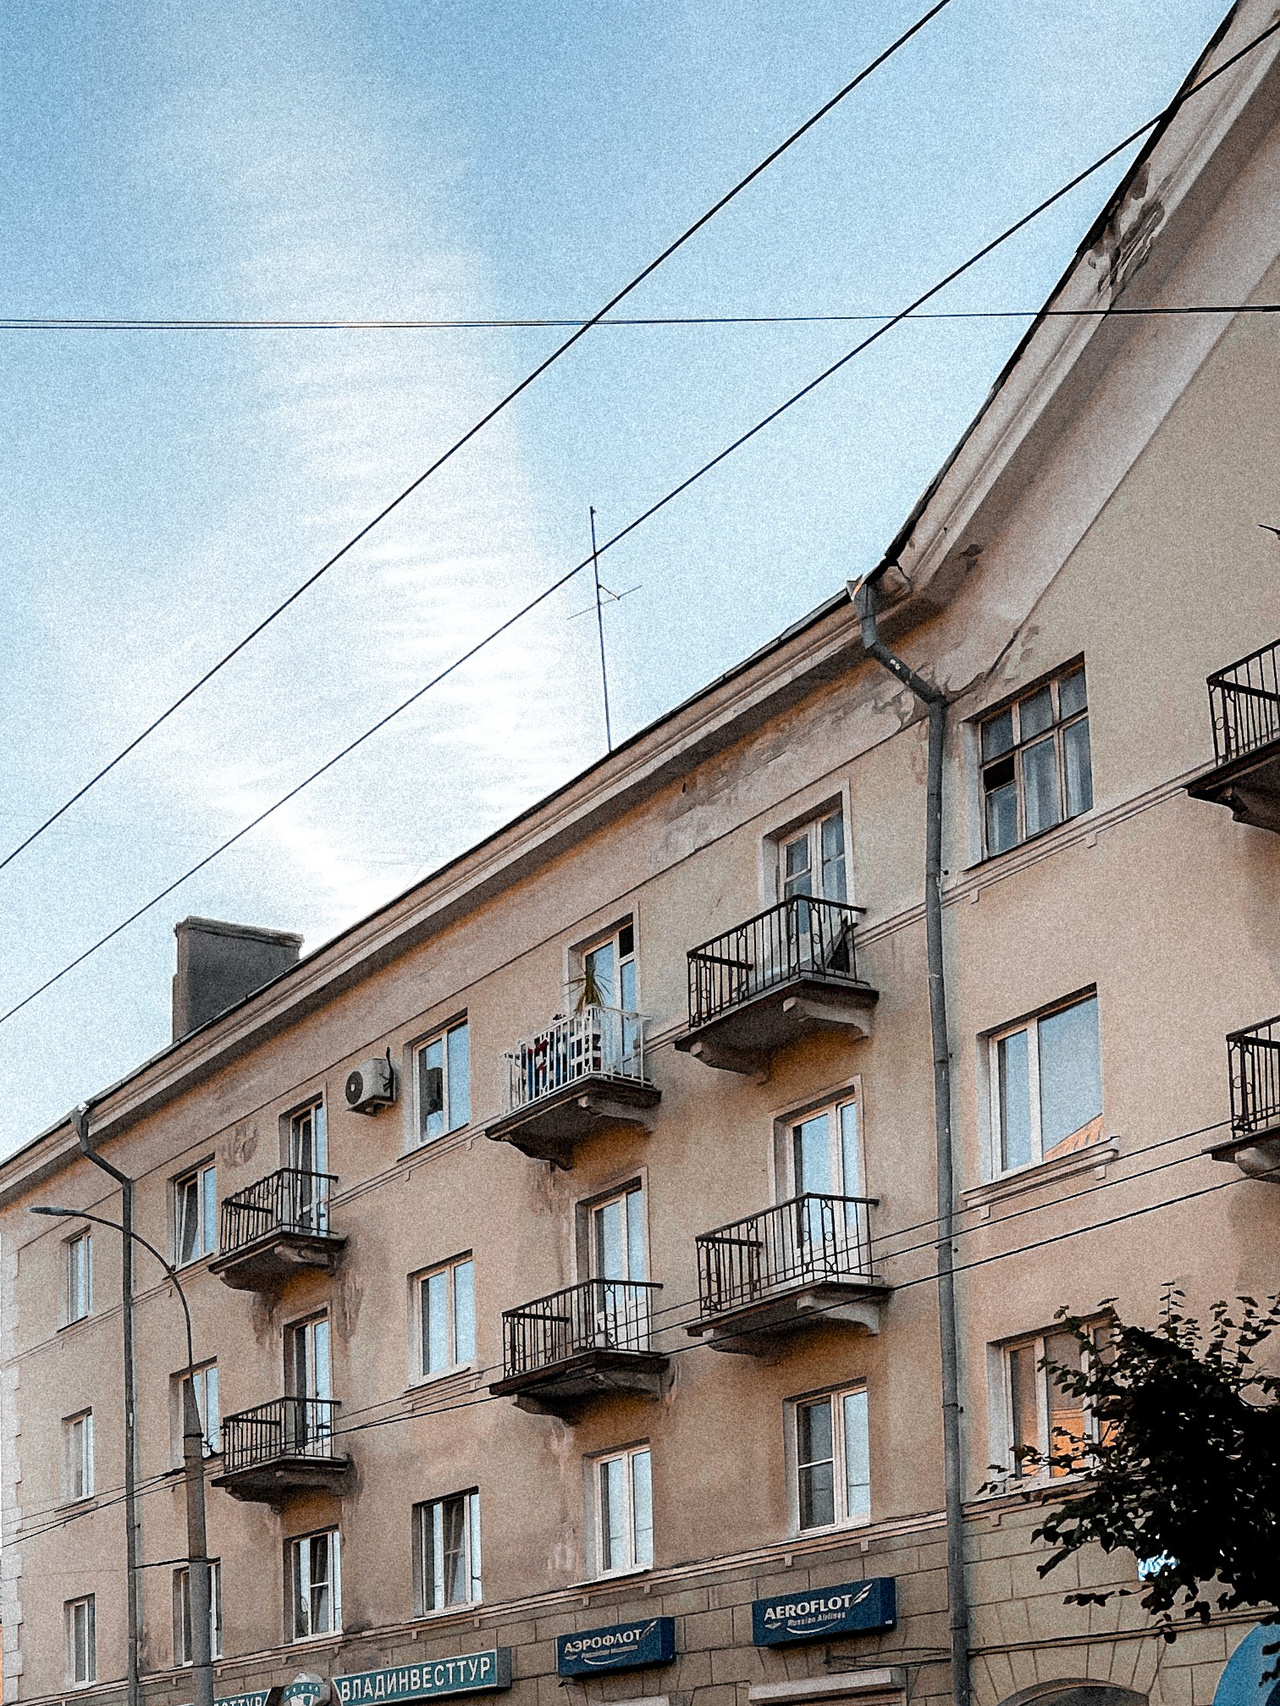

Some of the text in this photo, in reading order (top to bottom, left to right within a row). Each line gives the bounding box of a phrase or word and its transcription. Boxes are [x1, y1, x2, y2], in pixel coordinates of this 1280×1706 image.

[763, 1594, 853, 1621] AEROFLOT
[564, 1629, 642, 1653] АЭРОФЛОТ
[341, 1656, 491, 1701] ВЛАДИНВЕСТТУР
